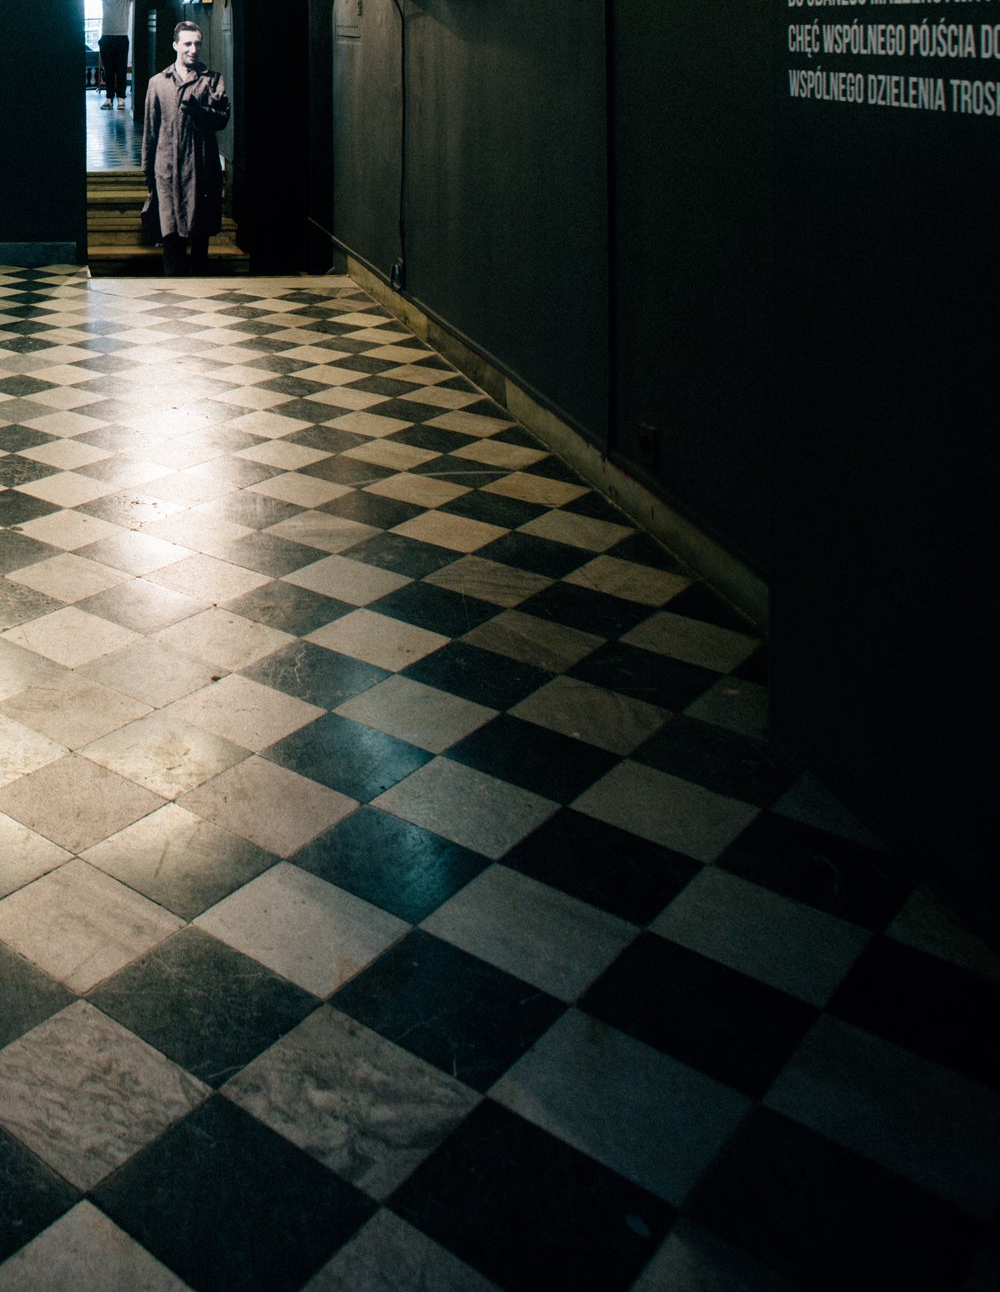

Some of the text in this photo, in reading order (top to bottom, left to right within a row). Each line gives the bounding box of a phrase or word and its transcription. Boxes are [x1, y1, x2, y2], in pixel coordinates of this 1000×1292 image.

[788, 18, 820, 58] CHĘĆ
[822, 18, 906, 56] WSPÓLNEGO
[909, 17, 976, 58] PÓJŚCIA
[788, 65, 1000, 117] WSPÓLNEGO DZIELENIA TROS
